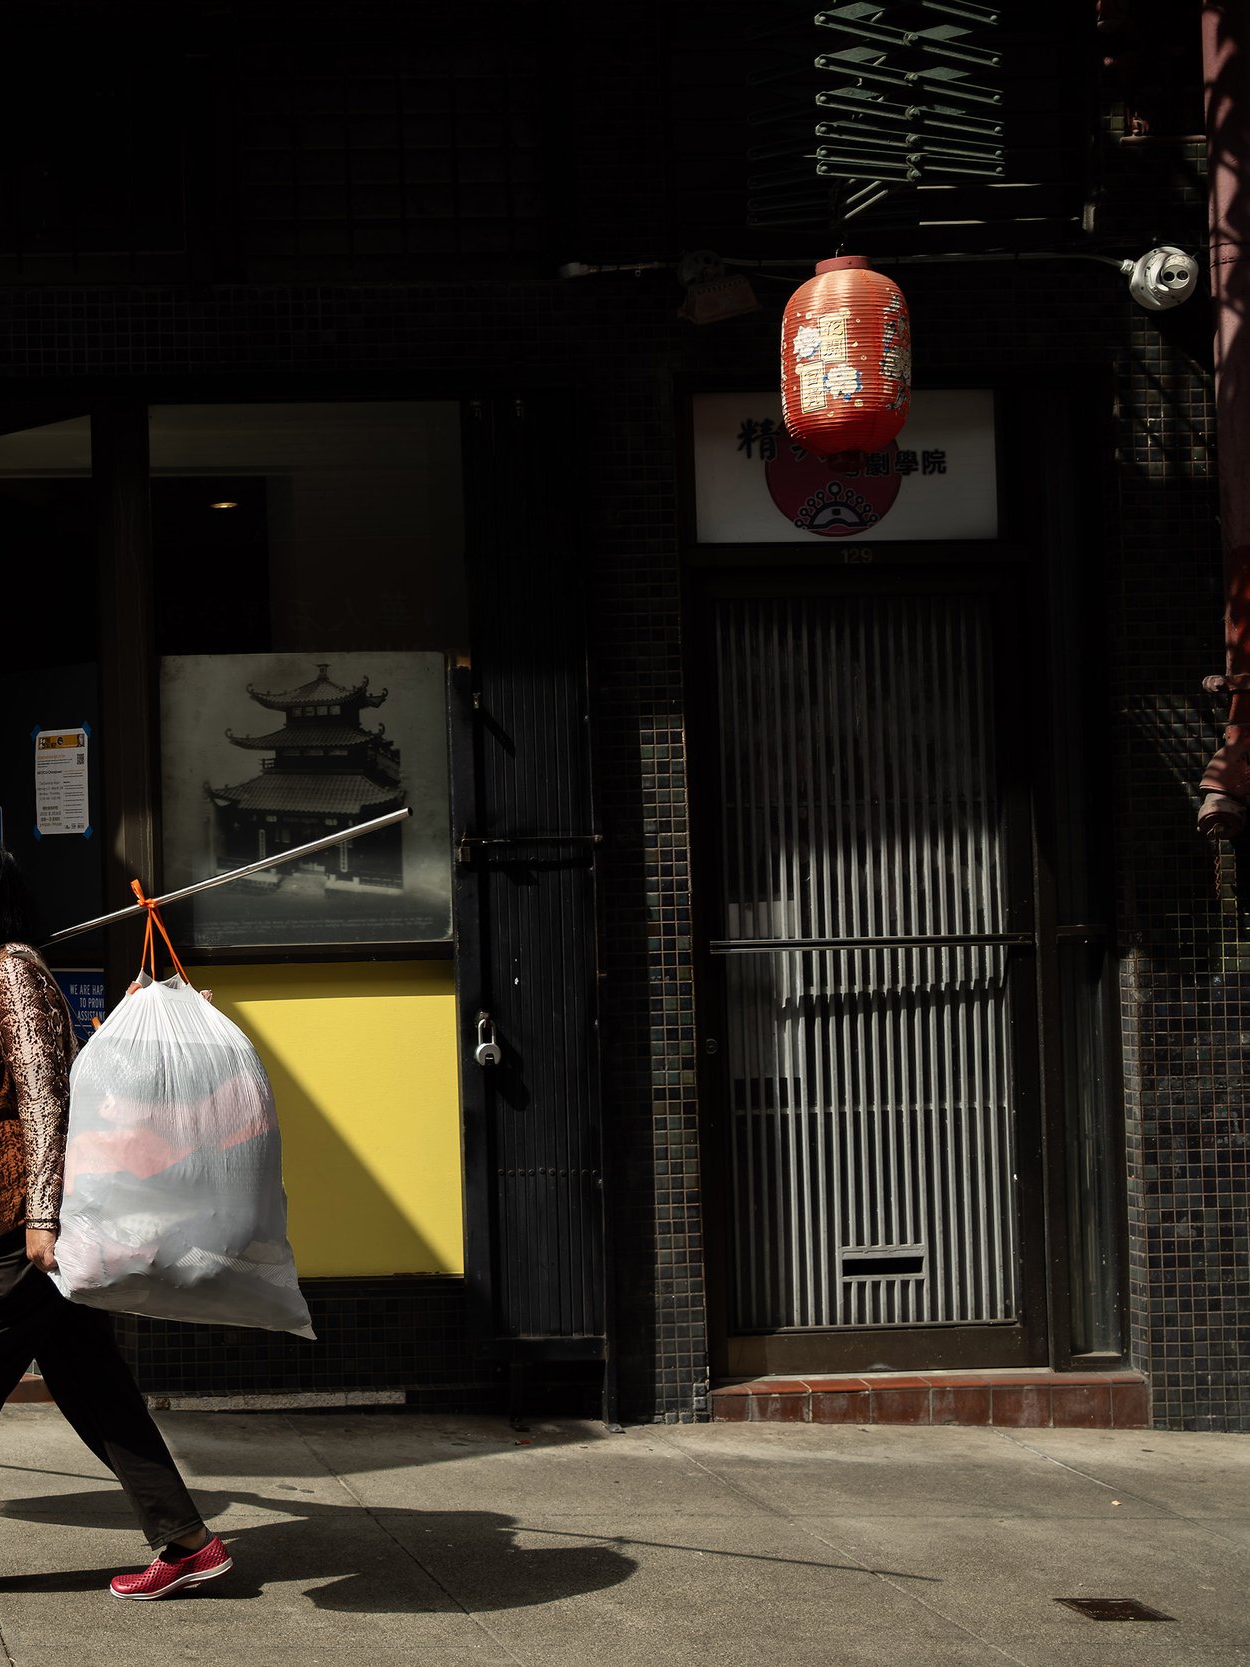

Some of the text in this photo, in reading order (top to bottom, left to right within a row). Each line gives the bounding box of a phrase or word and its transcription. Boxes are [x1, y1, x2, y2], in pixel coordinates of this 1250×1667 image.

[840, 547, 874, 564] 129
[69, 984, 104, 995] WE ARE HAP
[79, 998, 105, 1008] TO PROVI
